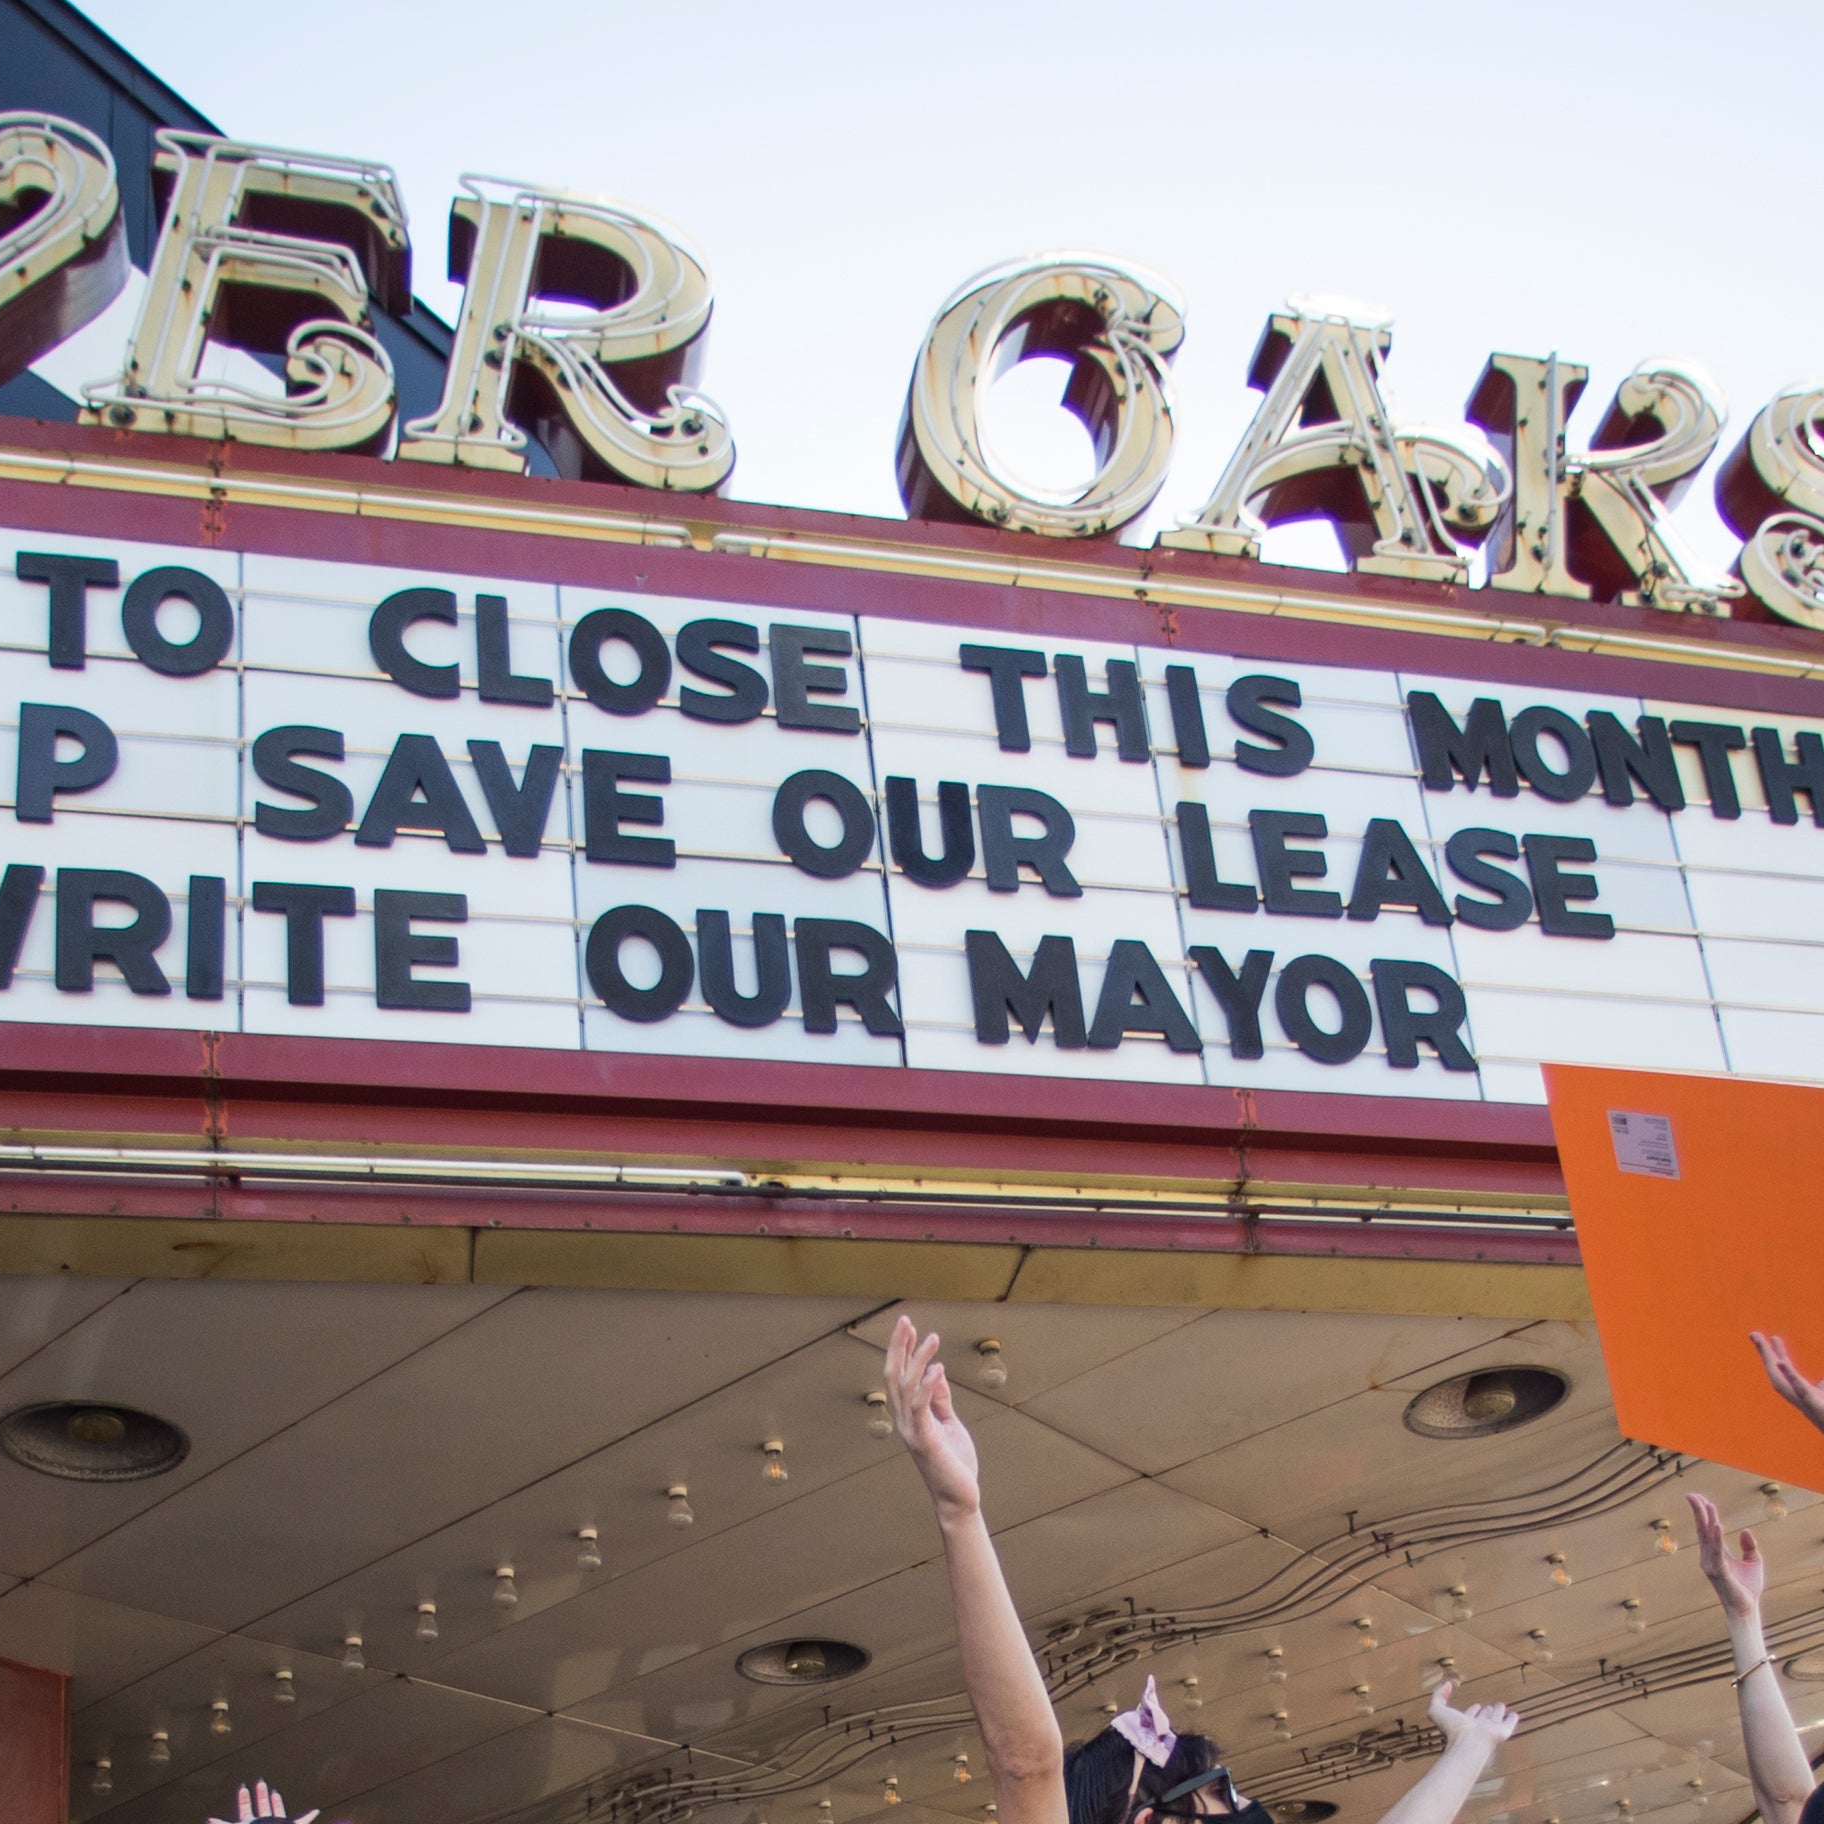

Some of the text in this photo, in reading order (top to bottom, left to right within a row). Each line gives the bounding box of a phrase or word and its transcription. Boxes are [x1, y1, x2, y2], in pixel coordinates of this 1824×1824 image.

[16, 550, 234, 678] TO
[369, 587, 862, 735] CLOSE
[959, 644, 1315, 777] THIS
[252, 725, 676, 868] SAVE
[772, 769, 1082, 898] OUR
[1175, 802, 1615, 940] LEASE
[587, 904, 905, 1036] OUR
[965, 929, 1478, 1071] MAYOR
